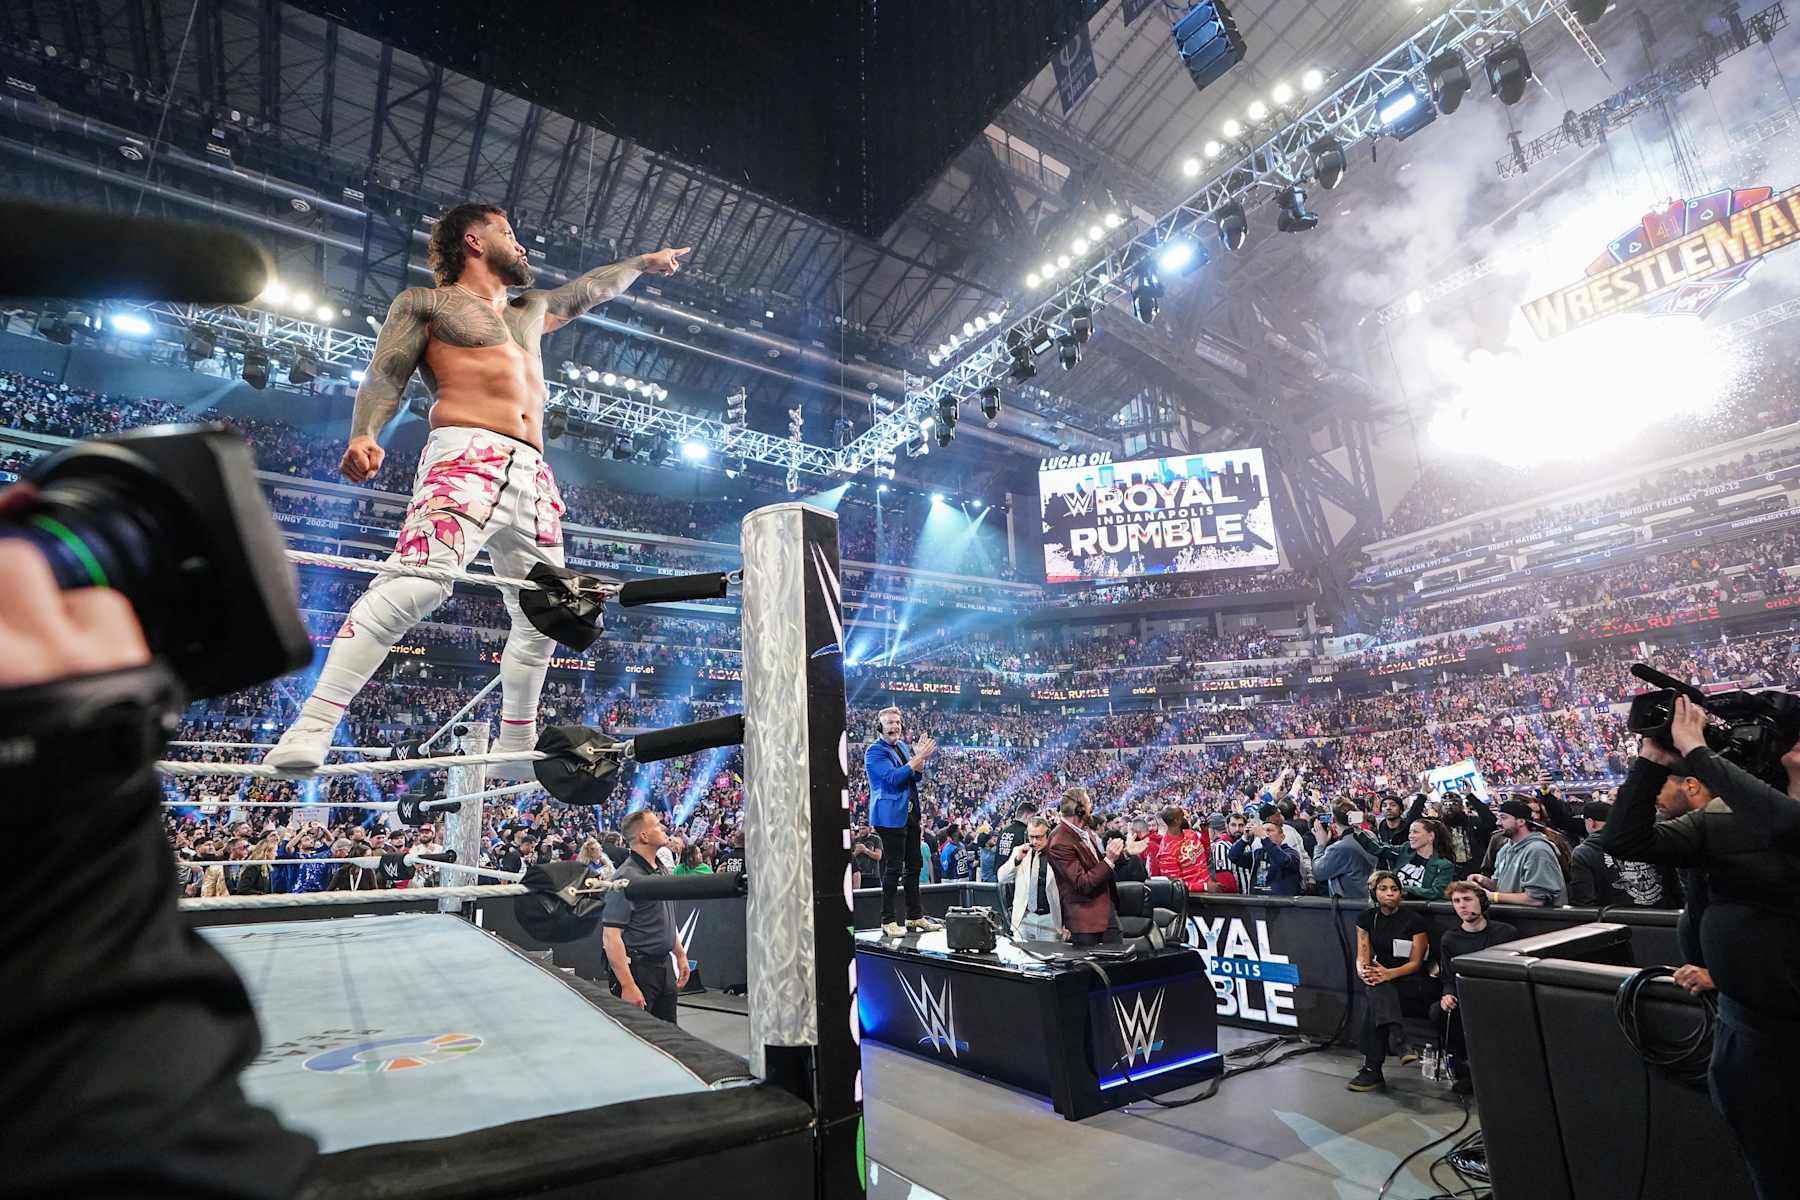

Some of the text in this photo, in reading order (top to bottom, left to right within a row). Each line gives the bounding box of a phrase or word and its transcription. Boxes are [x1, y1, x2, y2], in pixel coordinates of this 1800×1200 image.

[1526, 190, 1800, 340] WRESTLEMA
[1040, 451, 1113, 471] LUCAS OIL
[1096, 476, 1238, 515] ROYAL
[1097, 505, 1215, 526] INDIANAPOLIS
[1070, 514, 1244, 556] RUMBLE
[390, 644, 426, 656] cricket
[625, 664, 656, 675] cricket
[888, 680, 961, 694] ROYAL RUMBLE
[1211, 959, 1262, 977] POLIS
